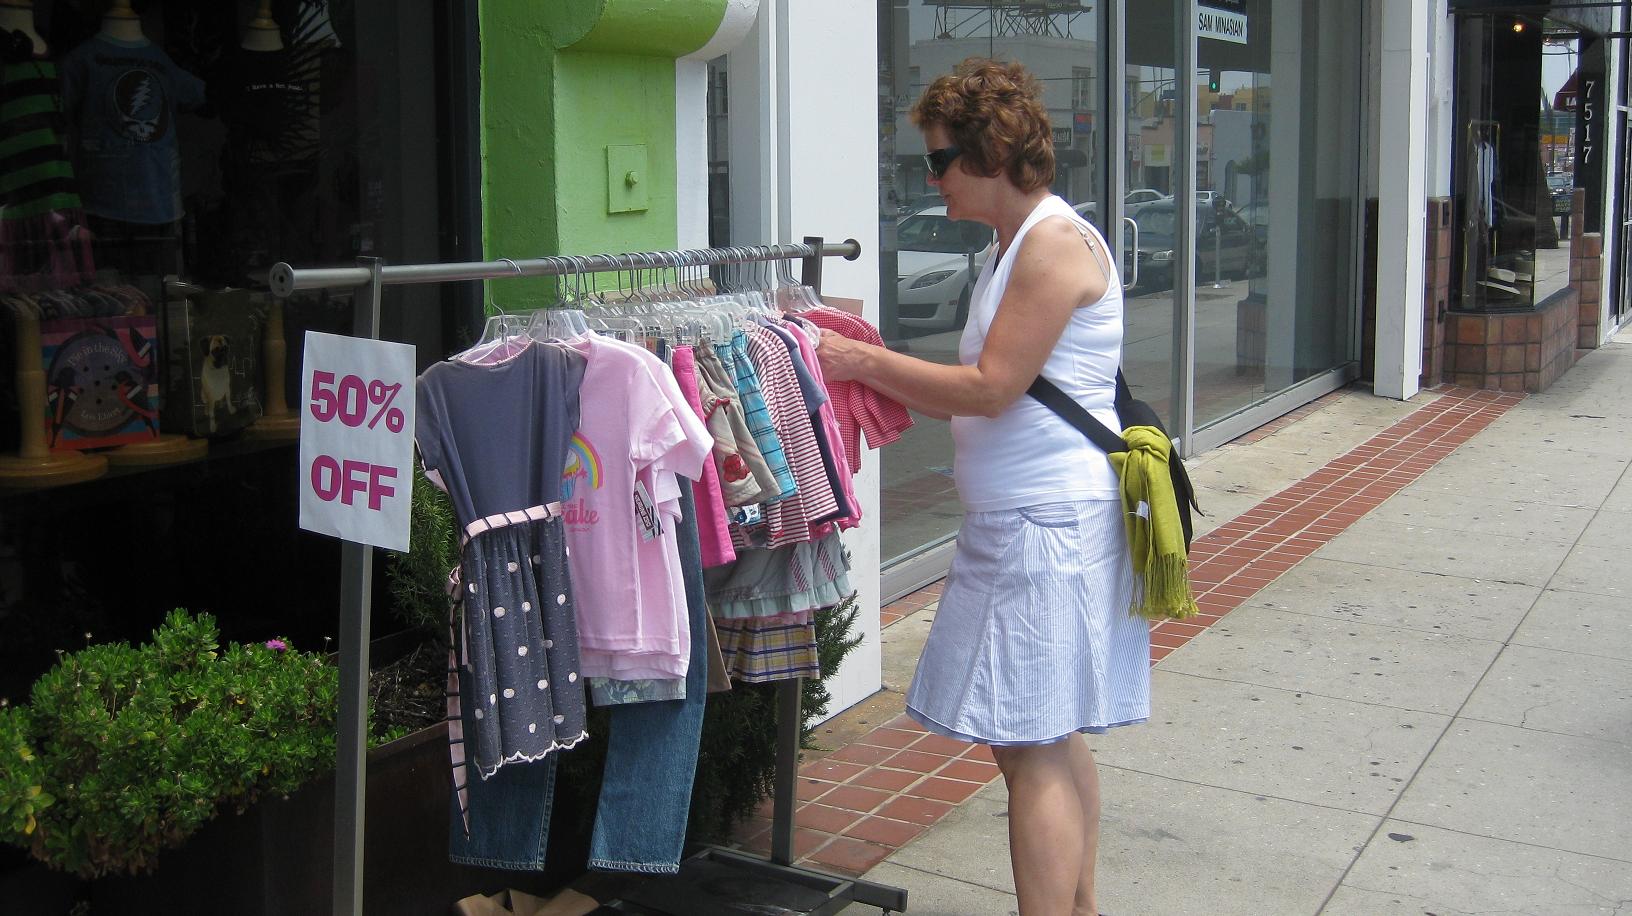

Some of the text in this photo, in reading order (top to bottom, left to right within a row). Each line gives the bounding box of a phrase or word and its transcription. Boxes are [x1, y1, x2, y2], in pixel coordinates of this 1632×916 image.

[1199, 12, 1244, 37] SAM MINASIAN
[94, 342, 110, 353] the
[310, 369, 405, 434] 50%
[311, 454, 398, 511] OFF
